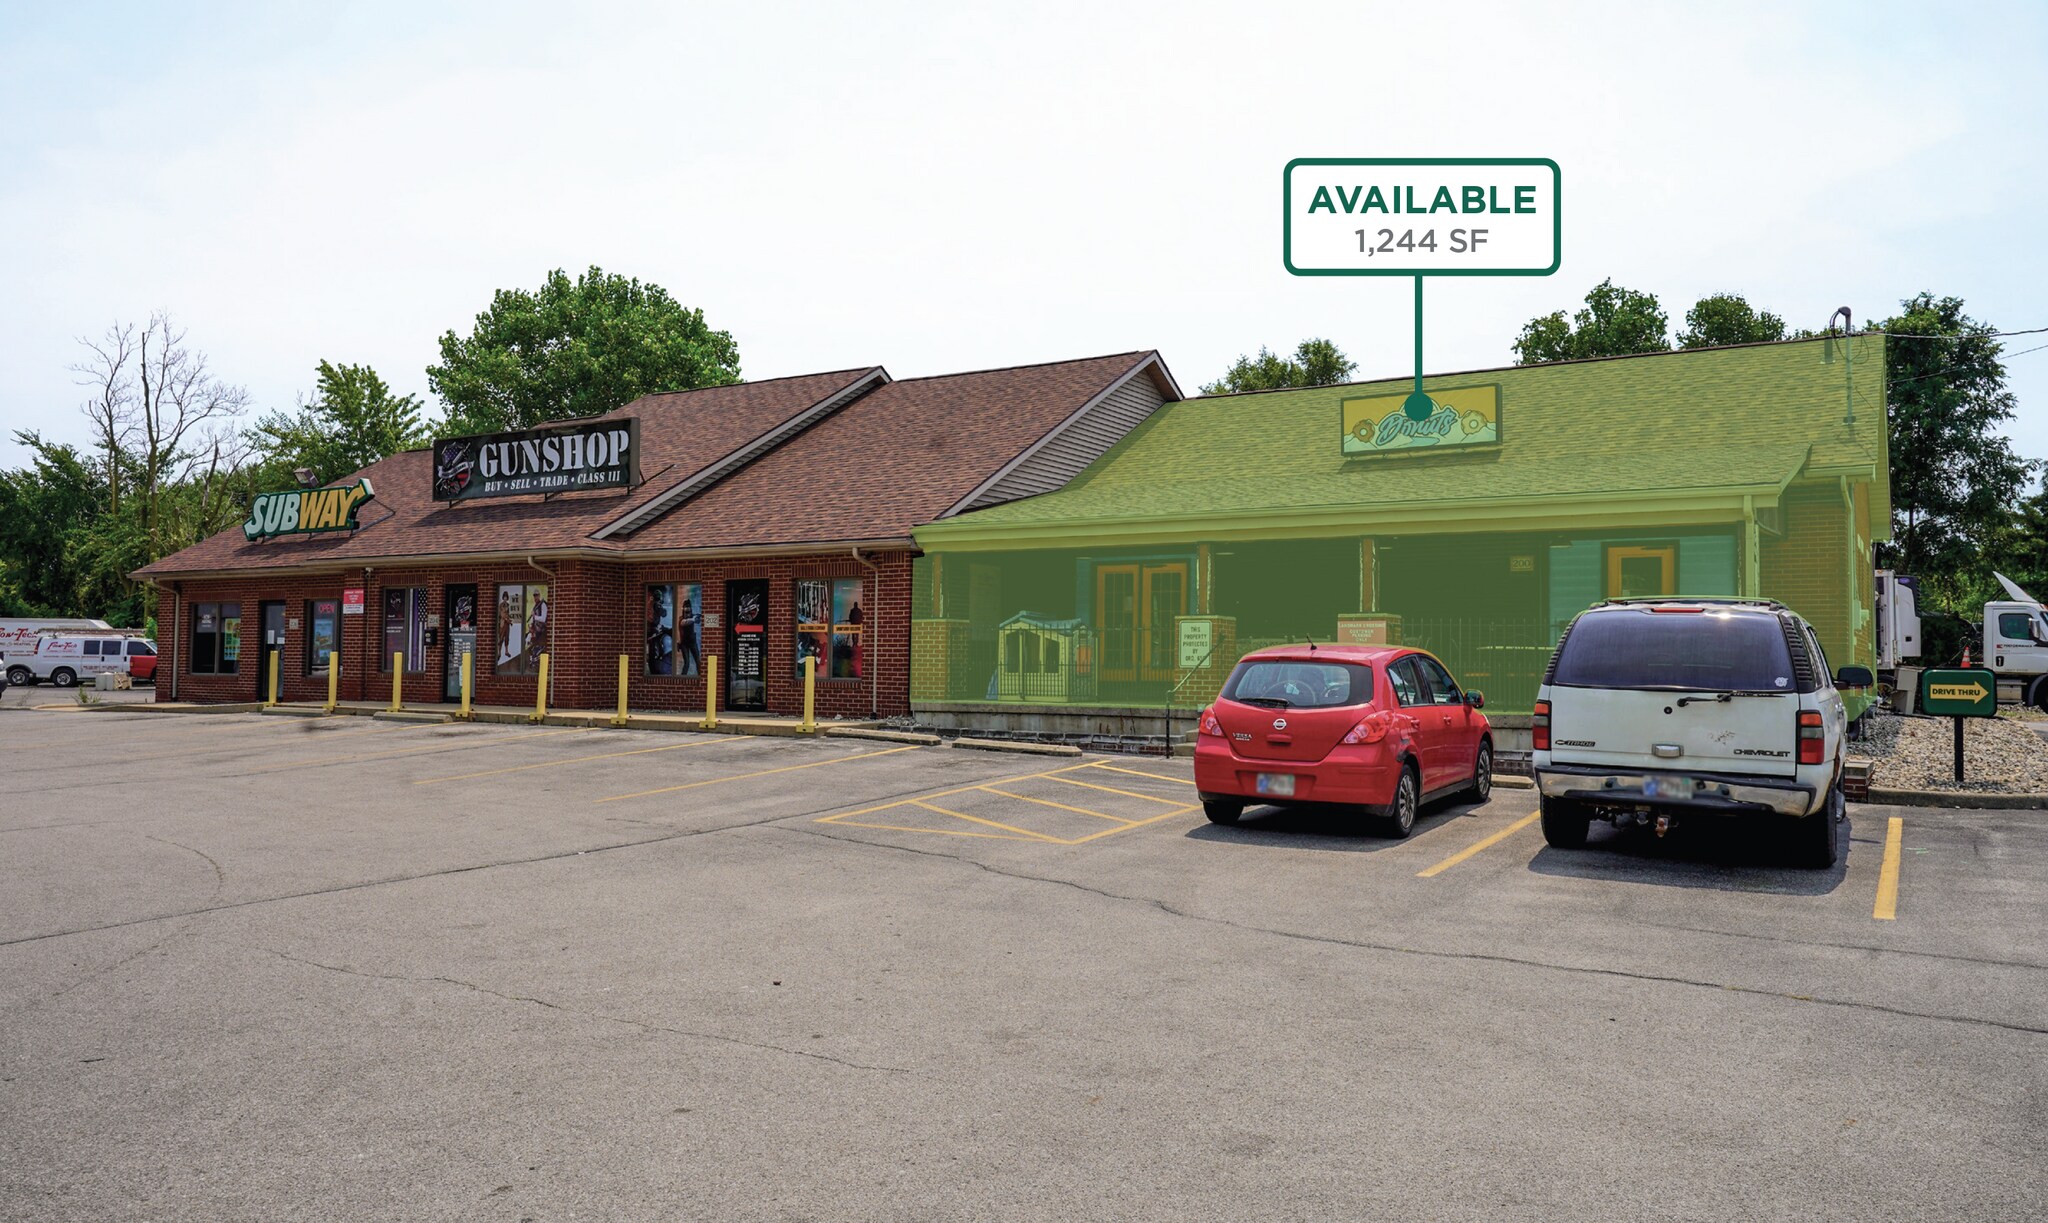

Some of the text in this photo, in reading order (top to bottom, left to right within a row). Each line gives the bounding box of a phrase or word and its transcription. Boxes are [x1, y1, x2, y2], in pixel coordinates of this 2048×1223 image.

[1376, 406, 1458, 445] Donuts
[479, 429, 630, 478] GUNSHOP
[485, 470, 621, 492] BUY SELL TRADE CLASS III
[243, 483, 367, 536] SUBWAY
[1512, 559, 1531, 567] 200
[319, 604, 335, 614] OPEN
[1932, 688, 1981, 696] DRIVE THRU
[1733, 748, 1791, 757] CHEVROLET
